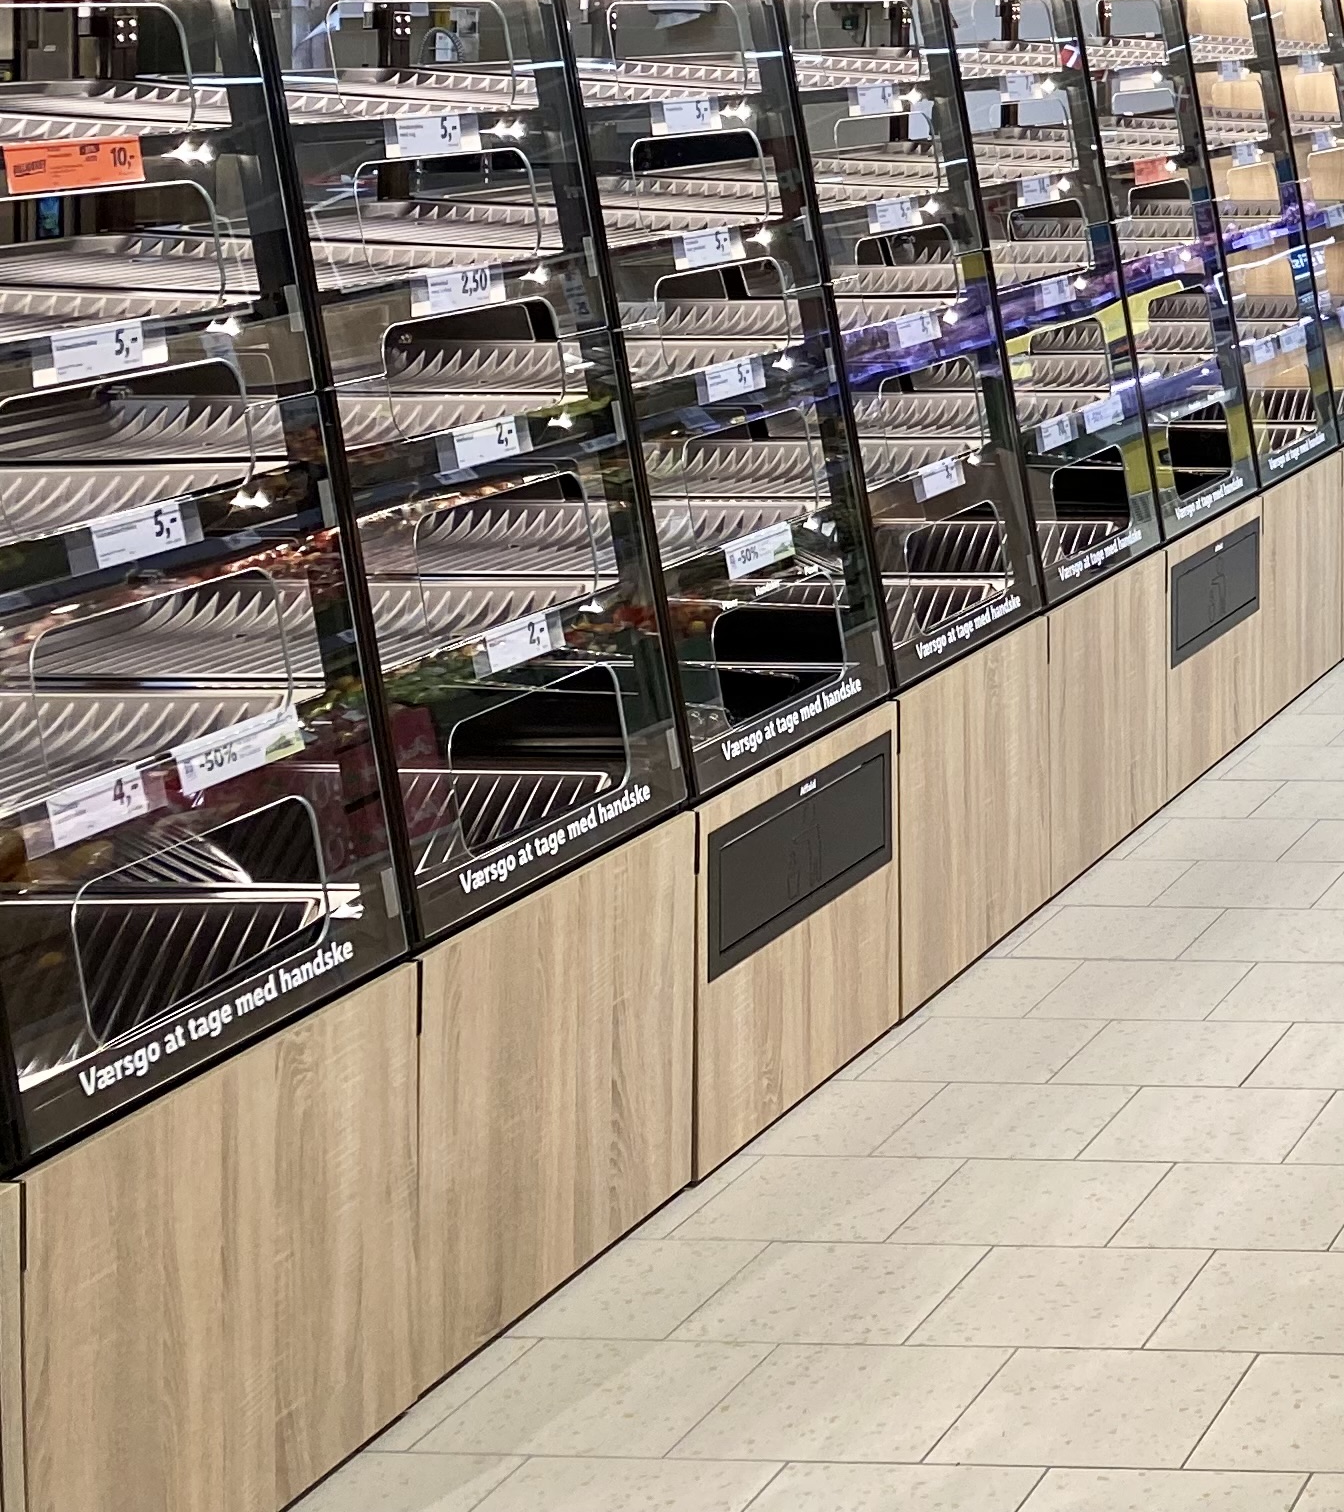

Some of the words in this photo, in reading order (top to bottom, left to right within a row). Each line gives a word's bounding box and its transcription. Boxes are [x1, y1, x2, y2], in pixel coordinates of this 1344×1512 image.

[199, 742, 238, 773] -50%
[721, 728, 764, 761] Værsgo
[764, 720, 776, 740] at
[776, 712, 799, 734] tage
[800, 695, 822, 721] med
[822, 677, 862, 710] handske
[112, 777, 140, 807] 4,-
[459, 855, 516, 894] Værsgo
[518, 842, 534, 864] at
[534, 829, 566, 855] tage
[566, 807, 598, 840] med
[598, 784, 651, 823] handske
[78, 1044, 160, 1096] Værsgo
[164, 1025, 186, 1054] at
[188, 1008, 233, 1044] tage
[235, 973, 278, 1016] med
[279, 940, 353, 990] handske
